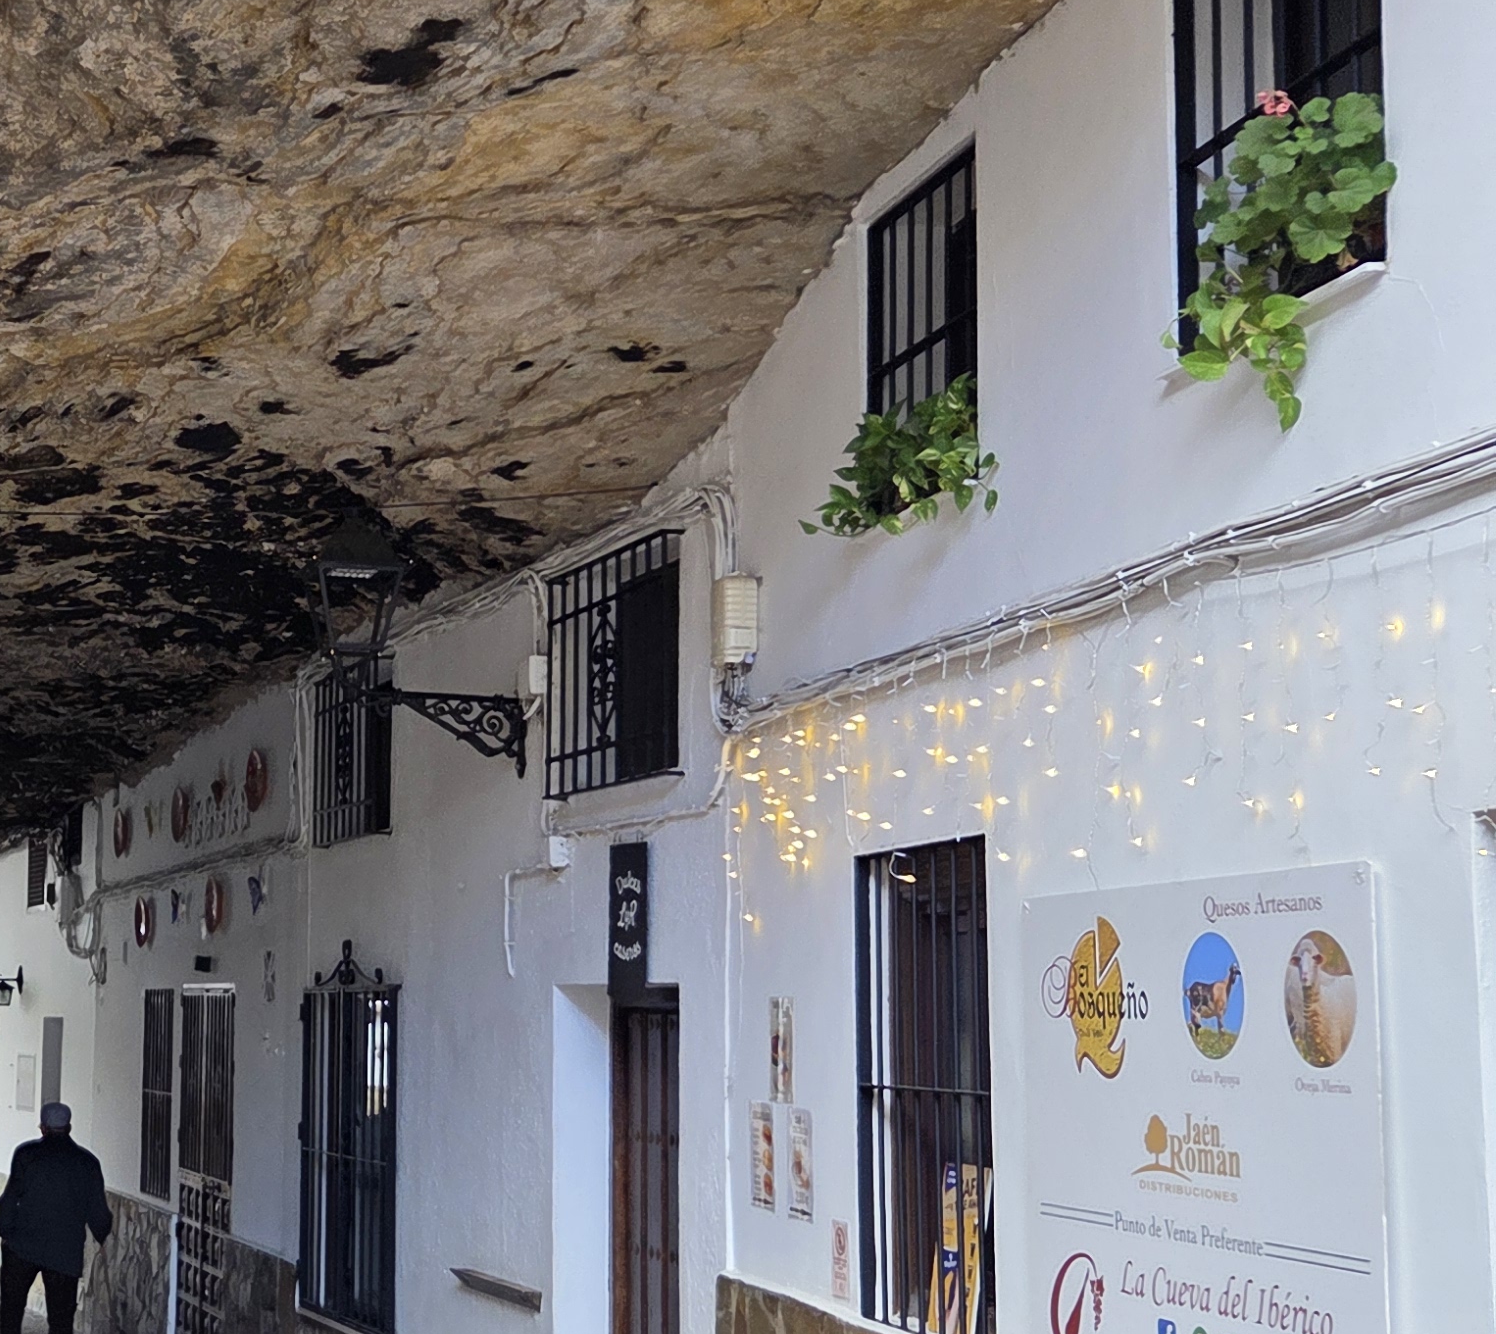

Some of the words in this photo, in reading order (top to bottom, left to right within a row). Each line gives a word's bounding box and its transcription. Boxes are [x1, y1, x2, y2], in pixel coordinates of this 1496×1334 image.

[1204, 895, 1250, 923] Quesos
[1254, 892, 1322, 915] Artesanos
[1041, 955, 1149, 1030] Bosqueño
[1078, 964, 1089, 988] El
[1182, 1112, 1220, 1148] Jaén
[1169, 1134, 1241, 1179] Román
[1138, 1178, 1239, 1203] DISTRIBUCIONES
[1114, 1210, 1146, 1236] Punto
[1148, 1215, 1162, 1238] de
[1163, 1219, 1197, 1245] Venta
[1200, 1224, 1264, 1257] Preferente
[1120, 1260, 1145, 1298] La
[1152, 1267, 1211, 1312] Cueva
[1218, 1275, 1253, 1322] del
